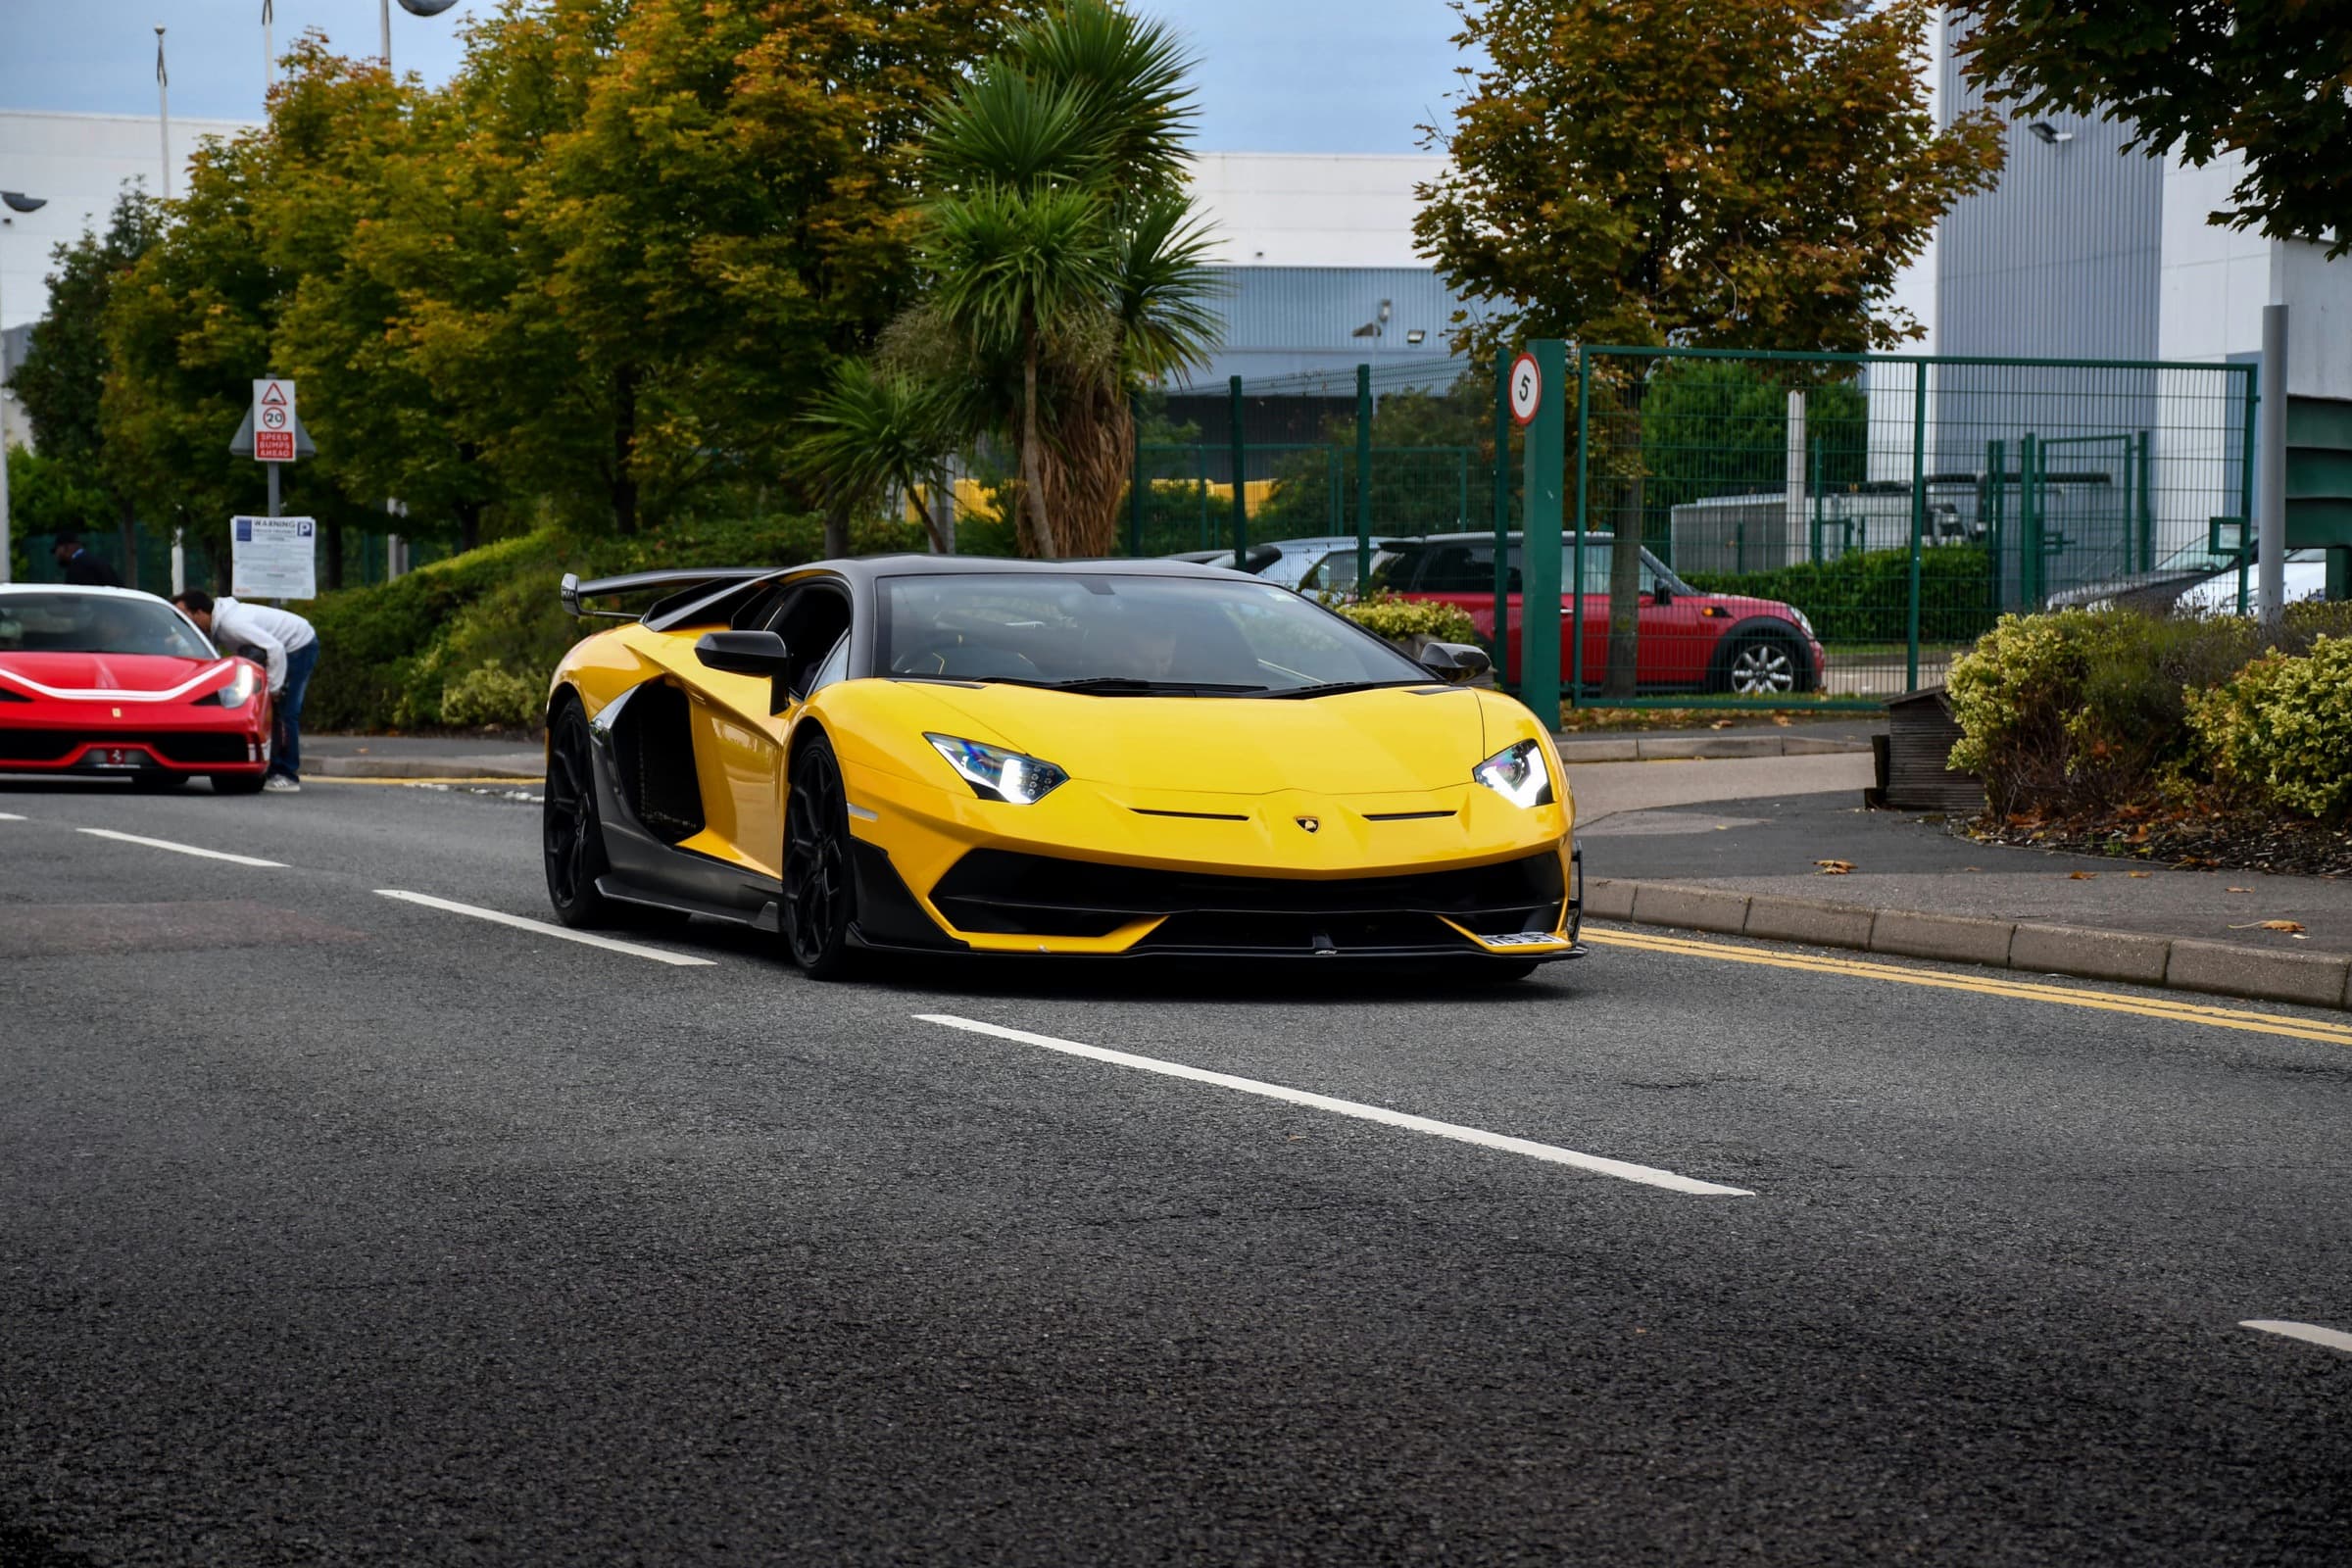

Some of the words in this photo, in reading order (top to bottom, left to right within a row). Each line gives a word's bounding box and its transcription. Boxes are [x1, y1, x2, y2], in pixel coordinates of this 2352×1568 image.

[1519, 373, 1531, 402] 5
[266, 413, 283, 422] 20
[254, 519, 296, 528] WARNING
[299, 522, 311, 535] P
